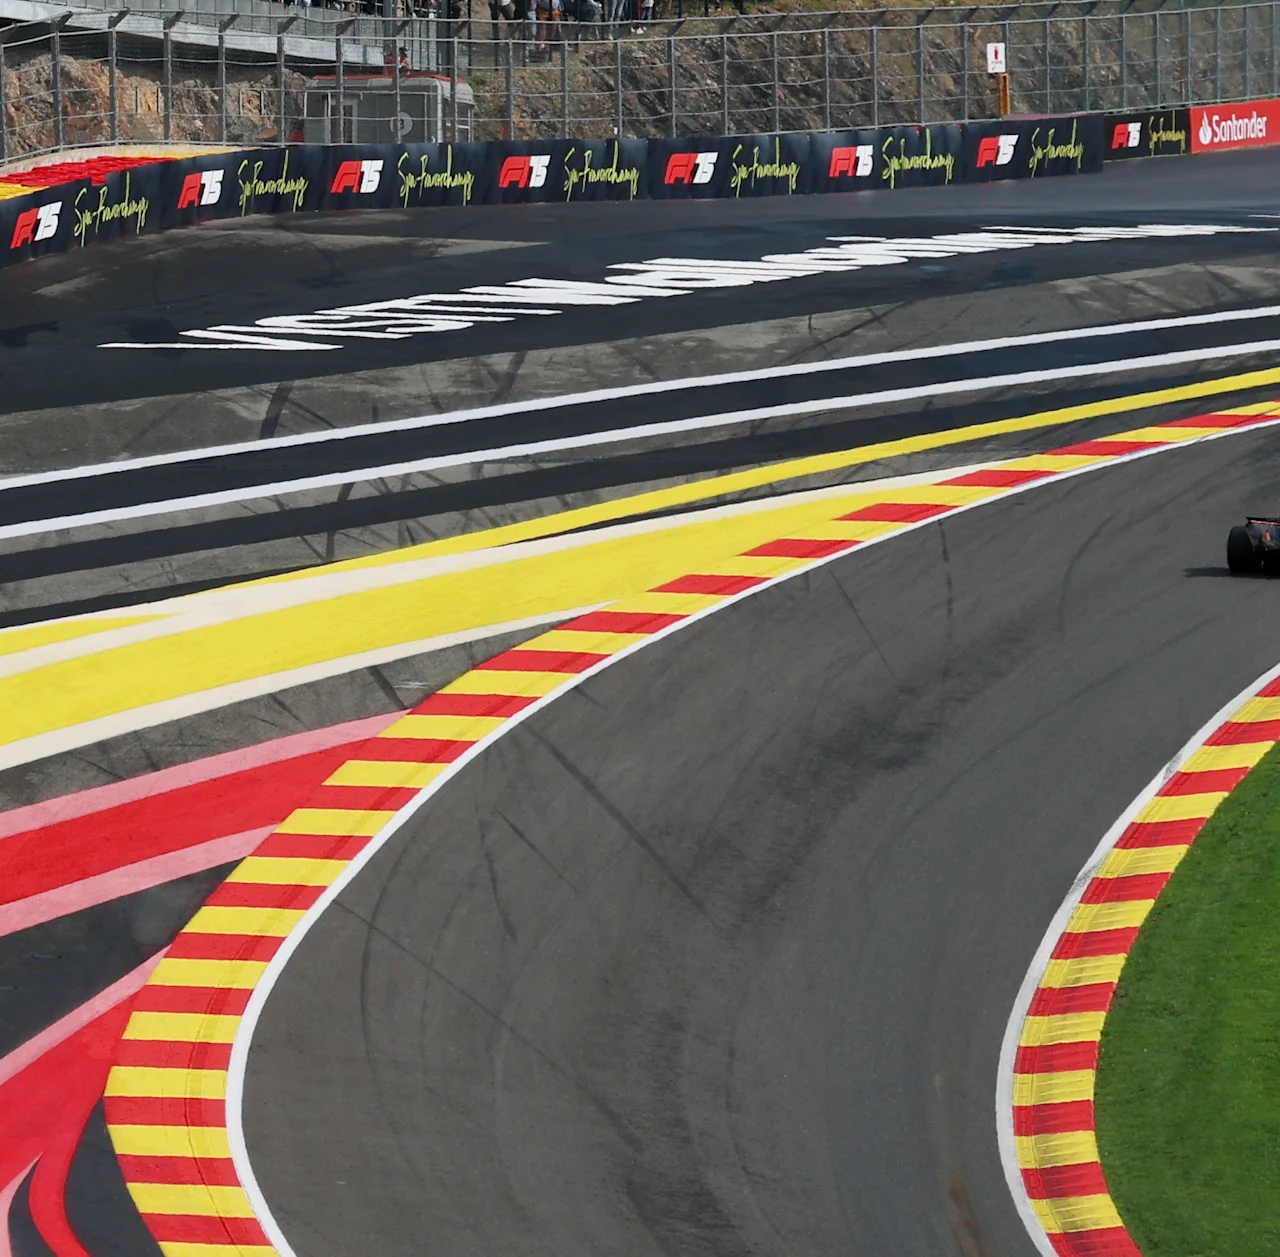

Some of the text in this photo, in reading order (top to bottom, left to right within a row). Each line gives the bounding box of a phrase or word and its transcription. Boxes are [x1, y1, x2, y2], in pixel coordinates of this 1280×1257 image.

[1111, 122, 1142, 150] F1 75
[1212, 110, 1268, 144] Santander
[664, 151, 719, 185] F1 75
[828, 144, 874, 178] F1 75
[976, 134, 1019, 168] F1 75
[330, 159, 384, 193] F1 75
[498, 154, 551, 188] F1 75
[177, 170, 225, 209] F1 75
[10, 201, 63, 249] F1 75
